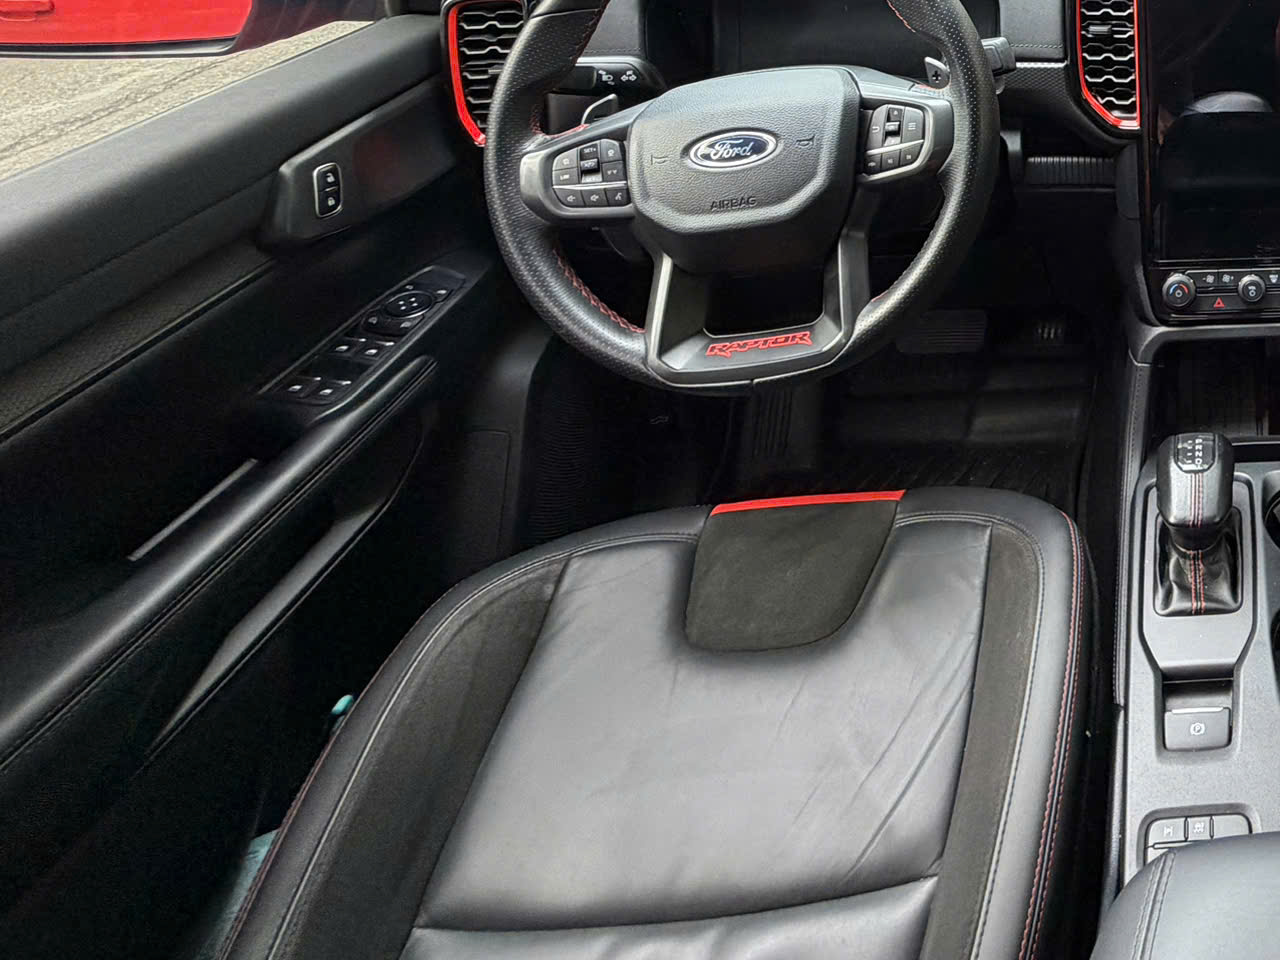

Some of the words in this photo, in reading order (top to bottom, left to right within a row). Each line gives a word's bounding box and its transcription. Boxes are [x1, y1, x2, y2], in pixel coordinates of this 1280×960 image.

[710, 139, 755, 160] Ford
[710, 195, 758, 211] AIRBAG
[705, 331, 813, 358] RAPTOR
